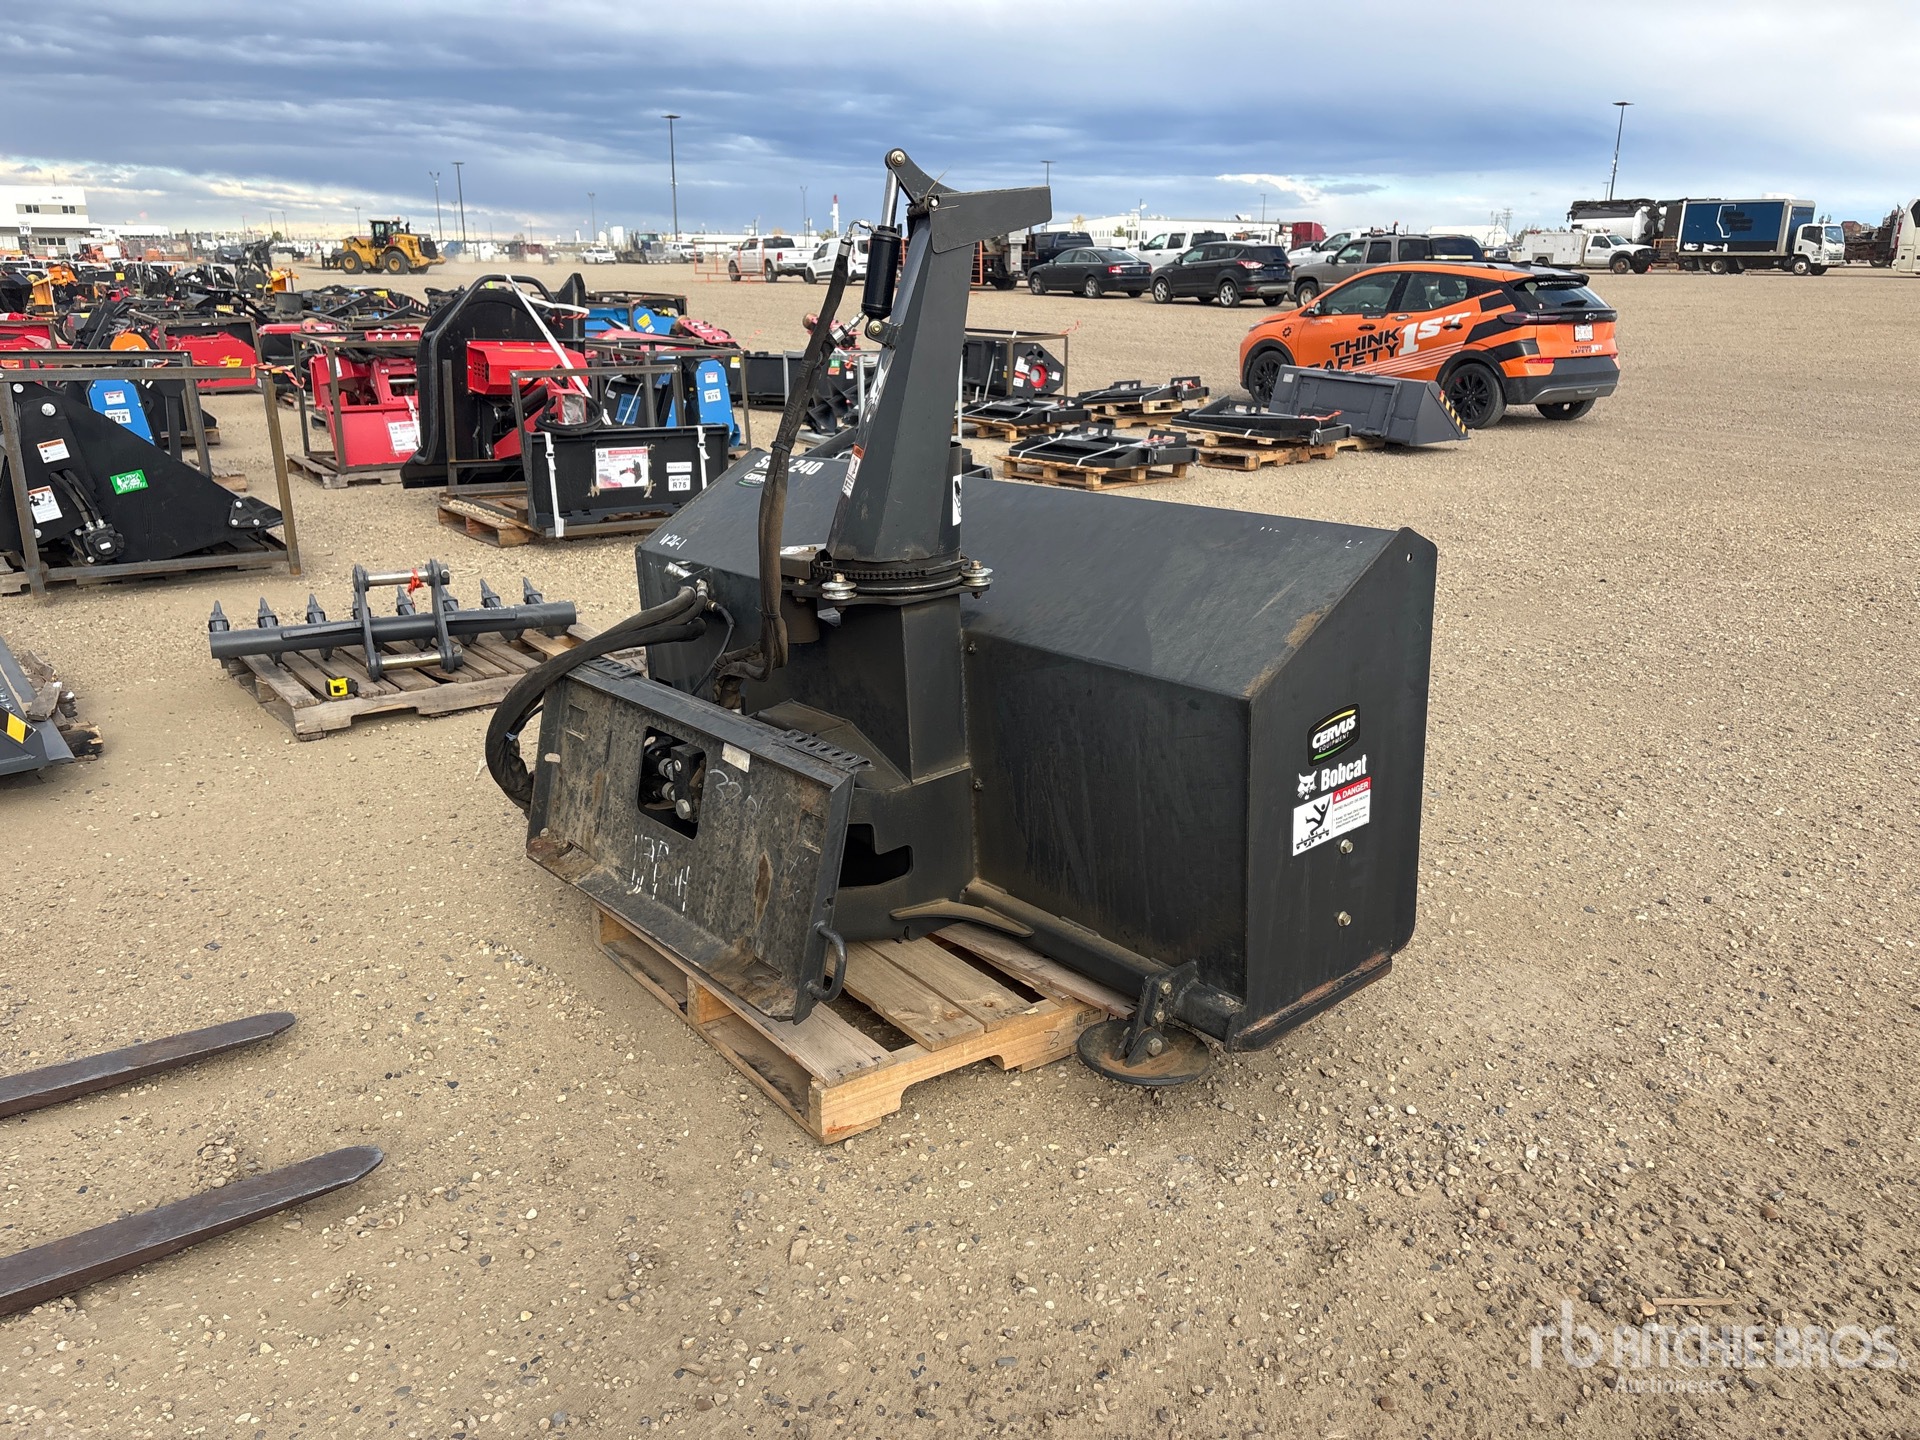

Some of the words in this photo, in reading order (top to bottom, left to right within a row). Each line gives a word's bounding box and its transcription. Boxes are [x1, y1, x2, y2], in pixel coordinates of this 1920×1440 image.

[1331, 326, 1402, 356] THINK
[1398, 312, 1472, 356] 1ST
[1307, 343, 1400, 369] AFETY
[1312, 714, 1356, 749] CERVUS
[1319, 732, 1350, 753] EQUIPMENT
[1321, 754, 1367, 792] Bobcat
[1342, 781, 1368, 798] DANGER
